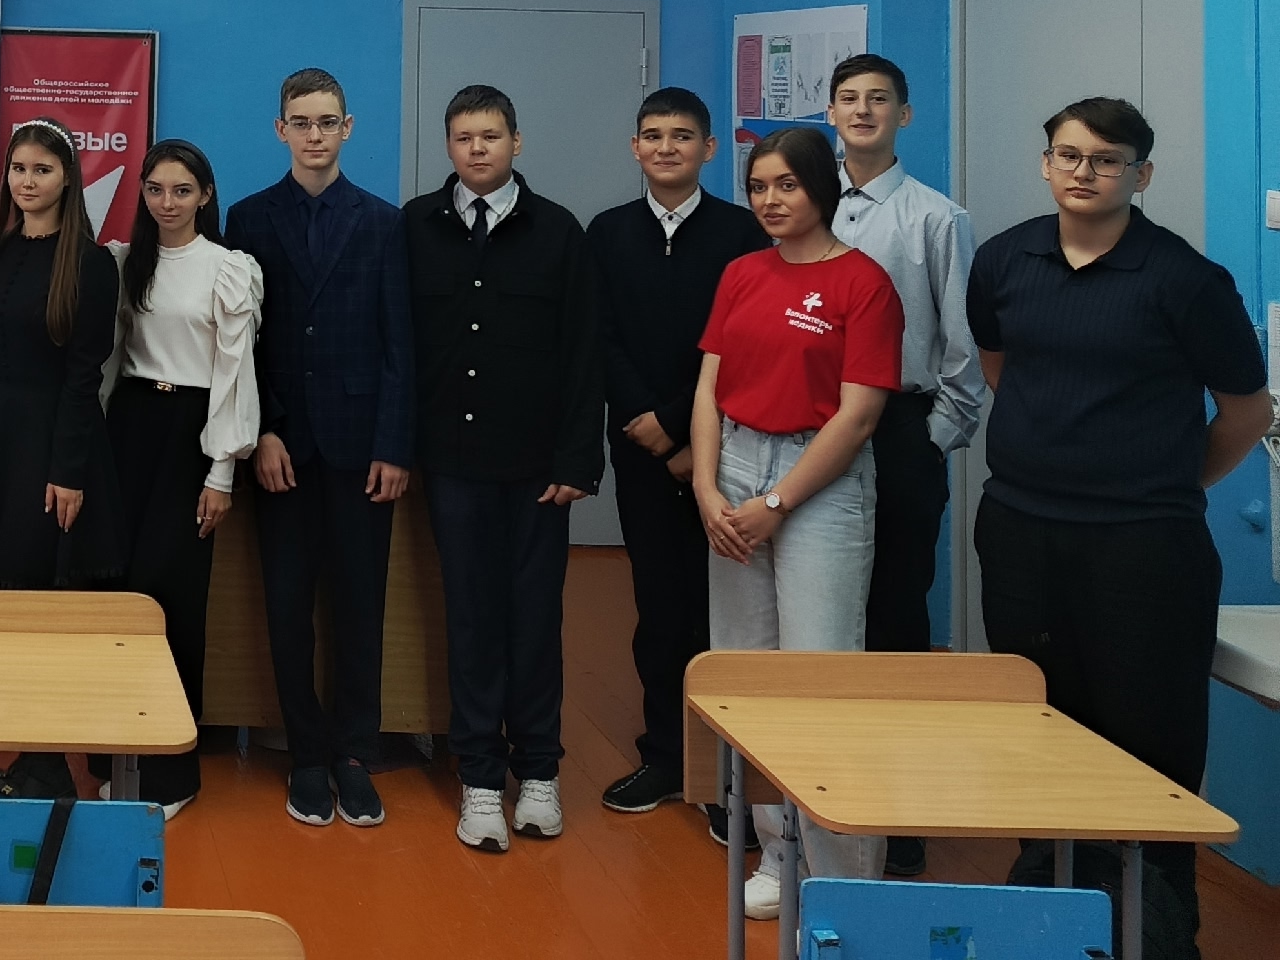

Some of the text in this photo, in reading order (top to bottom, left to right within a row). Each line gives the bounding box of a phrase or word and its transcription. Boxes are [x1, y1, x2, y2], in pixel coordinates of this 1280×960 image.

[33, 78, 110, 88] Общероссийское
[3, 86, 139, 97] общественно-государственное
[53, 96, 80, 104] детей
[784, 307, 833, 331] Волонтеры
[788, 319, 824, 335] медики
